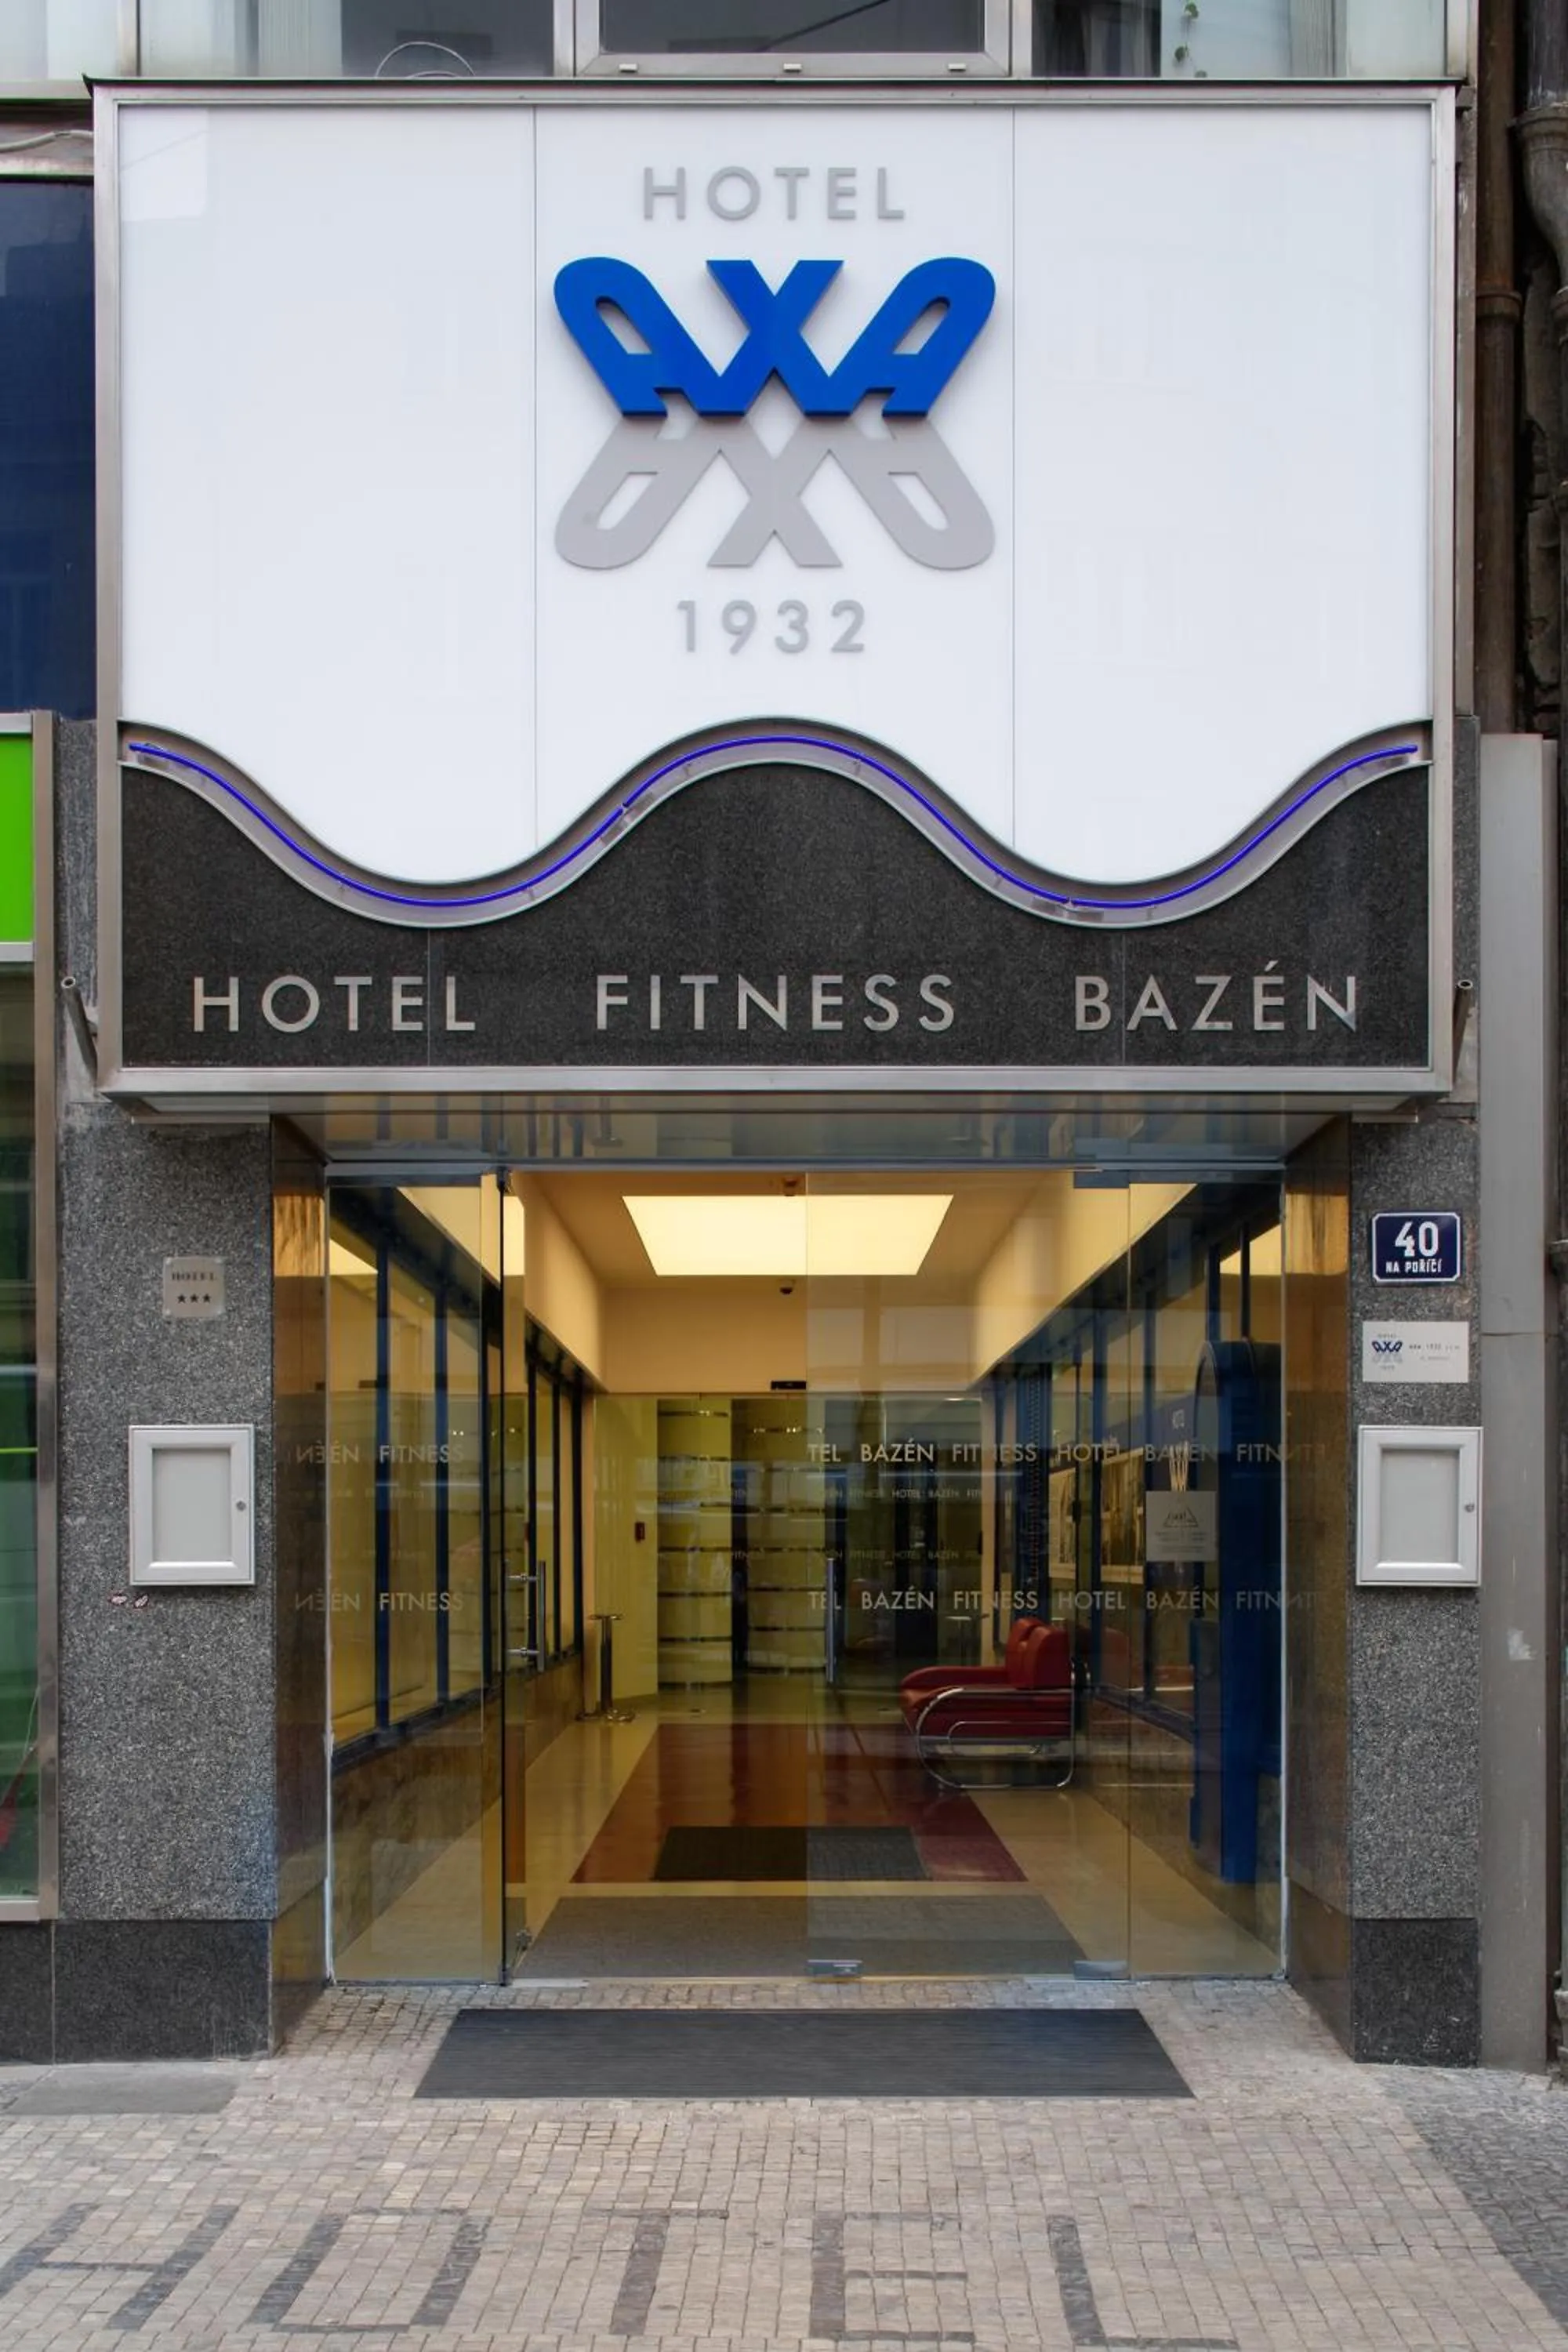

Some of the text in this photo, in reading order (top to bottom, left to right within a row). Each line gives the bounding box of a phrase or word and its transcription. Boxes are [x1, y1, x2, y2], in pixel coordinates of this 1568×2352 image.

[644, 166, 906, 221] HOTEL
[554, 256, 996, 419] AXA
[677, 600, 866, 655] 1932
[194, 960, 1356, 1033] HOTEL FITNESS BAZÉN
[1395, 1221, 1439, 1257] 40
[1386, 1258, 1442, 1273] NA POŘÍČÍ
[379, 1445, 464, 1464] FITNESS
[861, 1439, 935, 1462] BAZÉN
[1058, 1444, 1121, 1462] HOTEL
[379, 1592, 464, 1611] FITNESS
[862, 1585, 935, 1610] BAZÉN
[1058, 1592, 1126, 1610] HOTEL
[1146, 1587, 1219, 1610] BAZÉN
